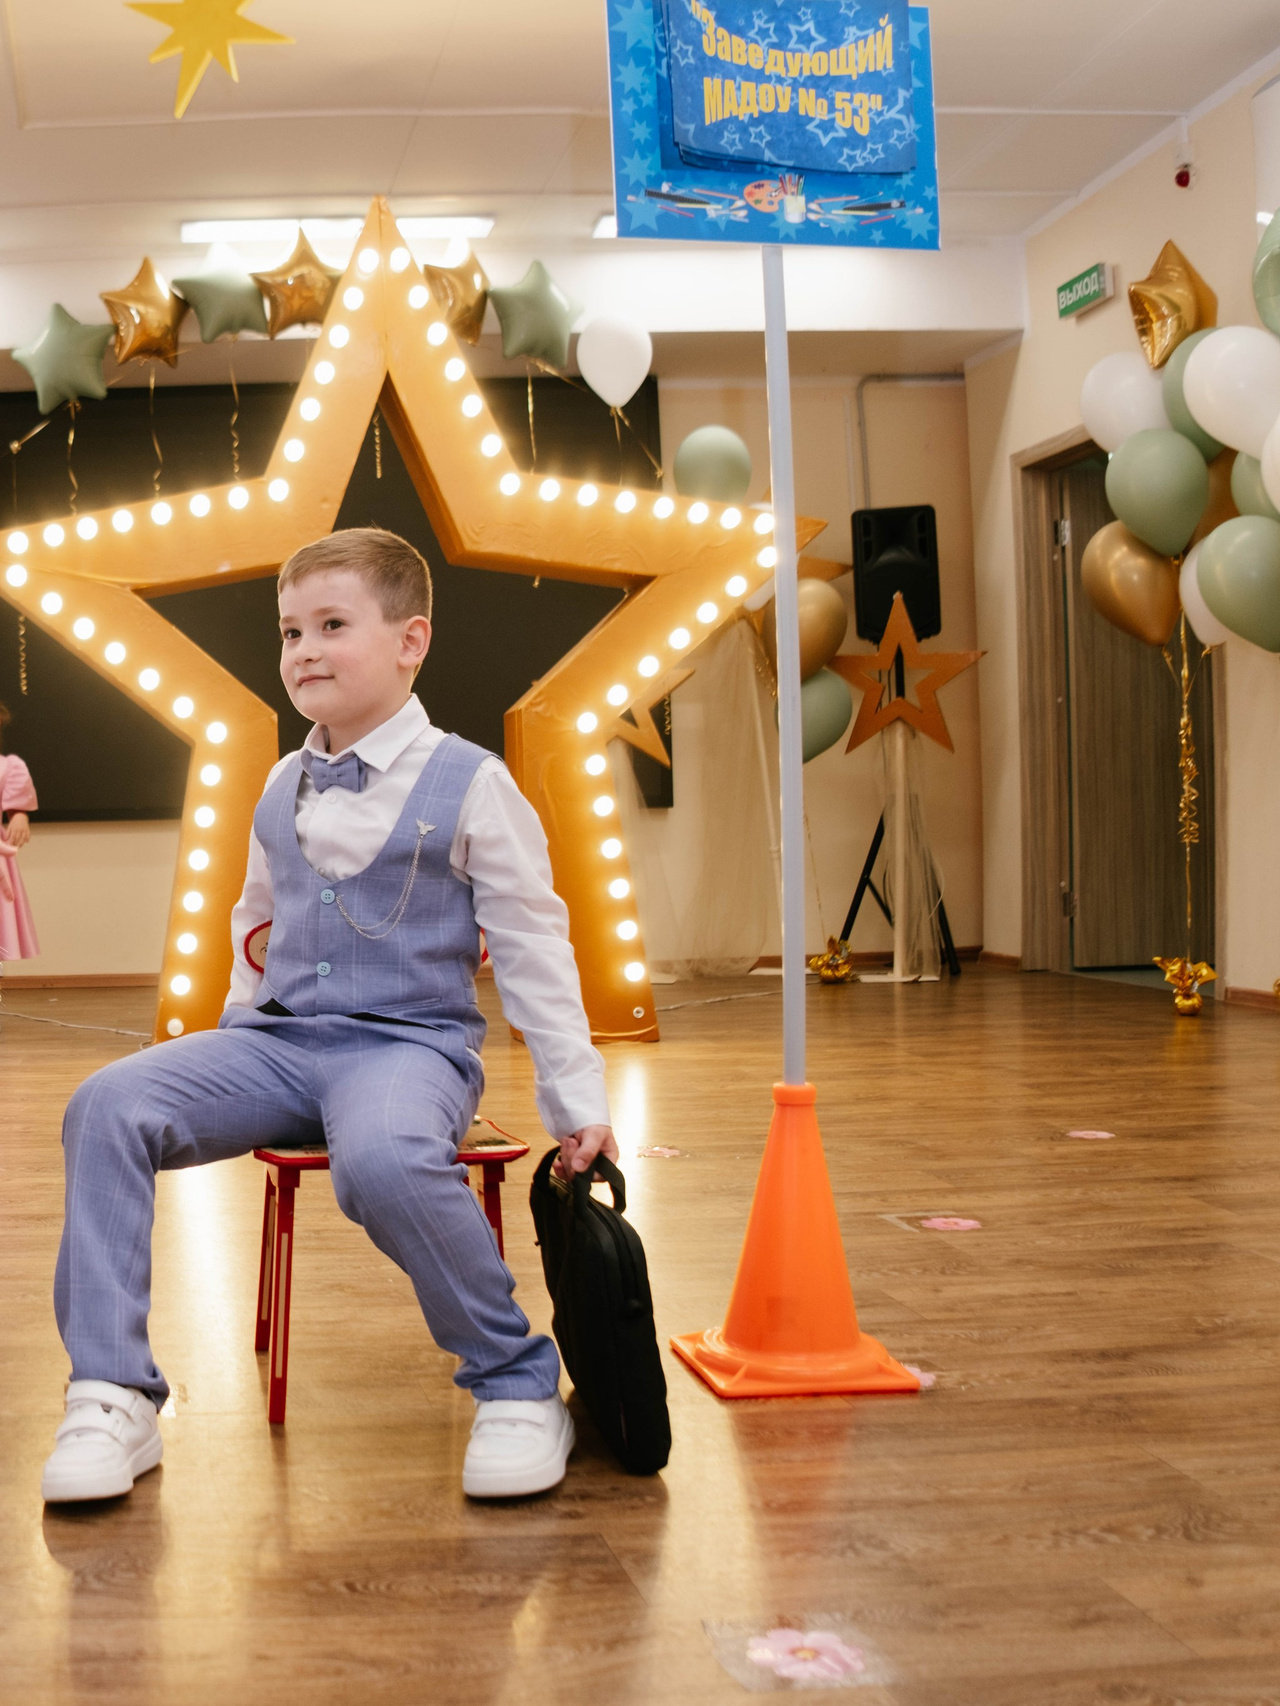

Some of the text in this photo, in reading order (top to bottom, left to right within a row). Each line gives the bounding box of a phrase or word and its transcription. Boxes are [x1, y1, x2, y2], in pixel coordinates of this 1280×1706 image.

[691, 0, 893, 80] "Заведующий
[703, 77, 882, 136] МАДОУ № 53"
[1058, 271, 1099, 311] ВЫХОД
